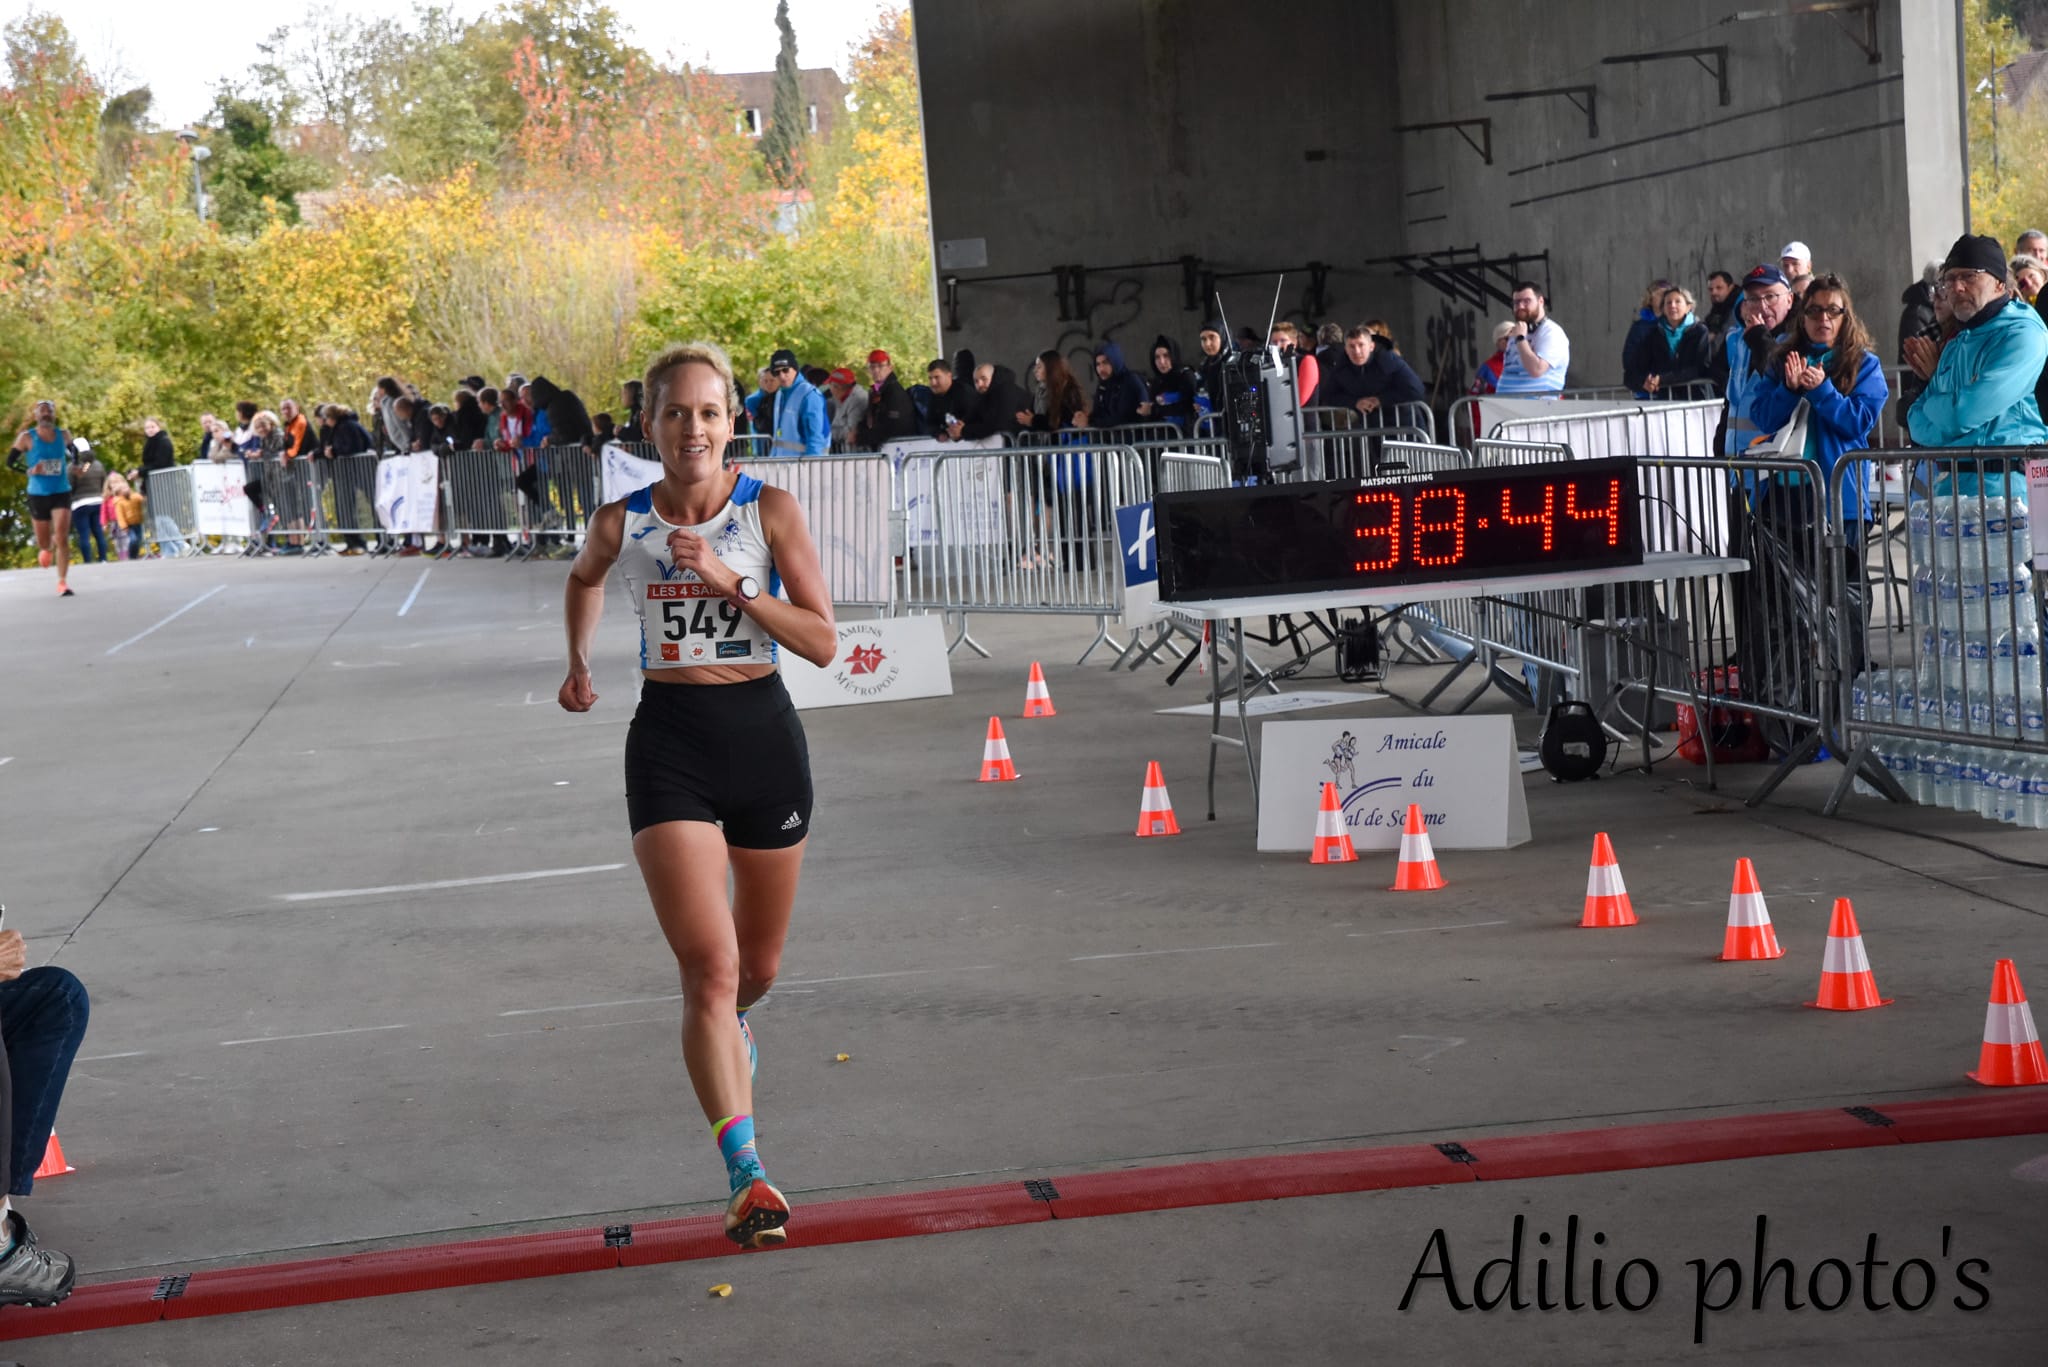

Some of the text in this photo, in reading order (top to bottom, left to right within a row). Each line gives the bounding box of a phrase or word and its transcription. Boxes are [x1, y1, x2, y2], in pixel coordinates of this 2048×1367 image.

[1360, 473, 1434, 487] MATSPORT TIMING
[652, 586, 677, 598] LES
[680, 585, 689, 597] 4
[662, 599, 742, 641] 549
[837, 624, 882, 641] AMIENS
[833, 665, 900, 697] MÉTROPOLE
[1376, 730, 1447, 753] Amicale
[1412, 768, 1434, 788] du
[1364, 807, 1383, 826] de
[1386, 809, 1446, 828] Some
